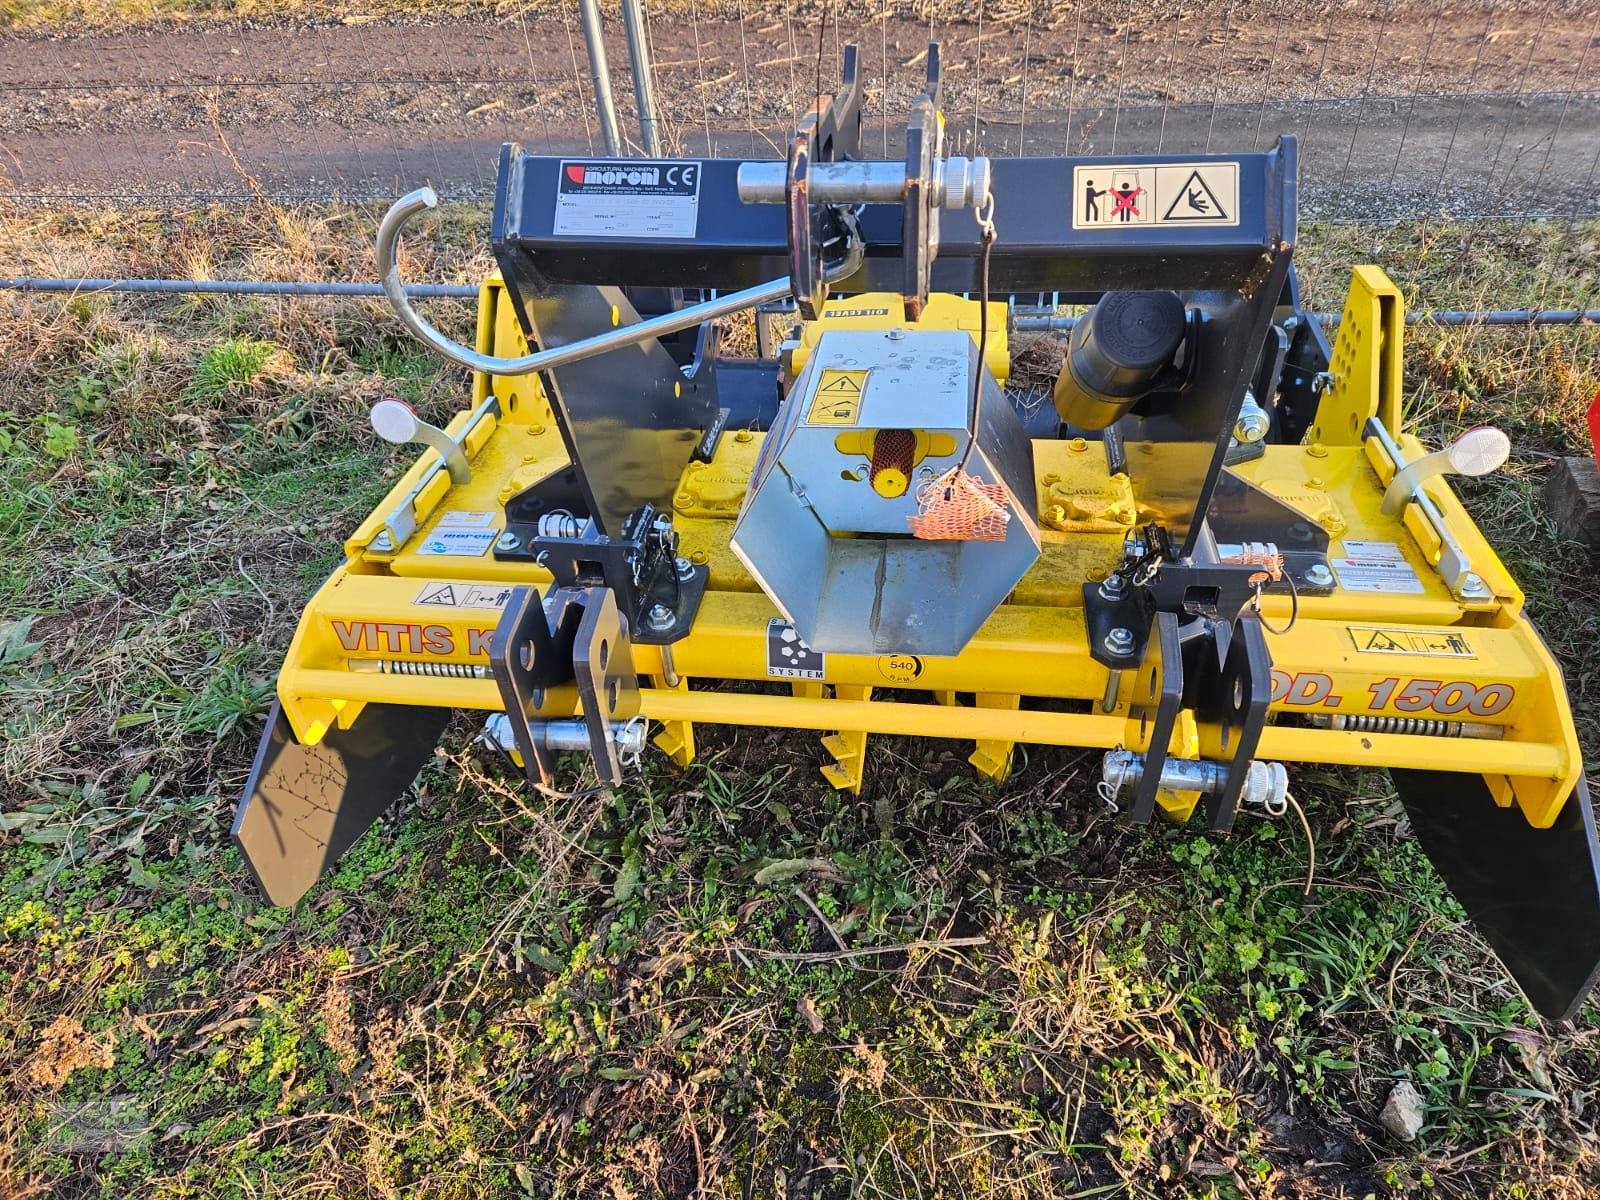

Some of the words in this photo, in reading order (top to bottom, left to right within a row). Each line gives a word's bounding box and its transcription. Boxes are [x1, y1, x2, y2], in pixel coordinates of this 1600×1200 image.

[331, 621, 455, 655] VITIS
[769, 667, 823, 679] SYSTEM
[890, 661, 914, 671] 540
[1368, 678, 1515, 716] 1500
